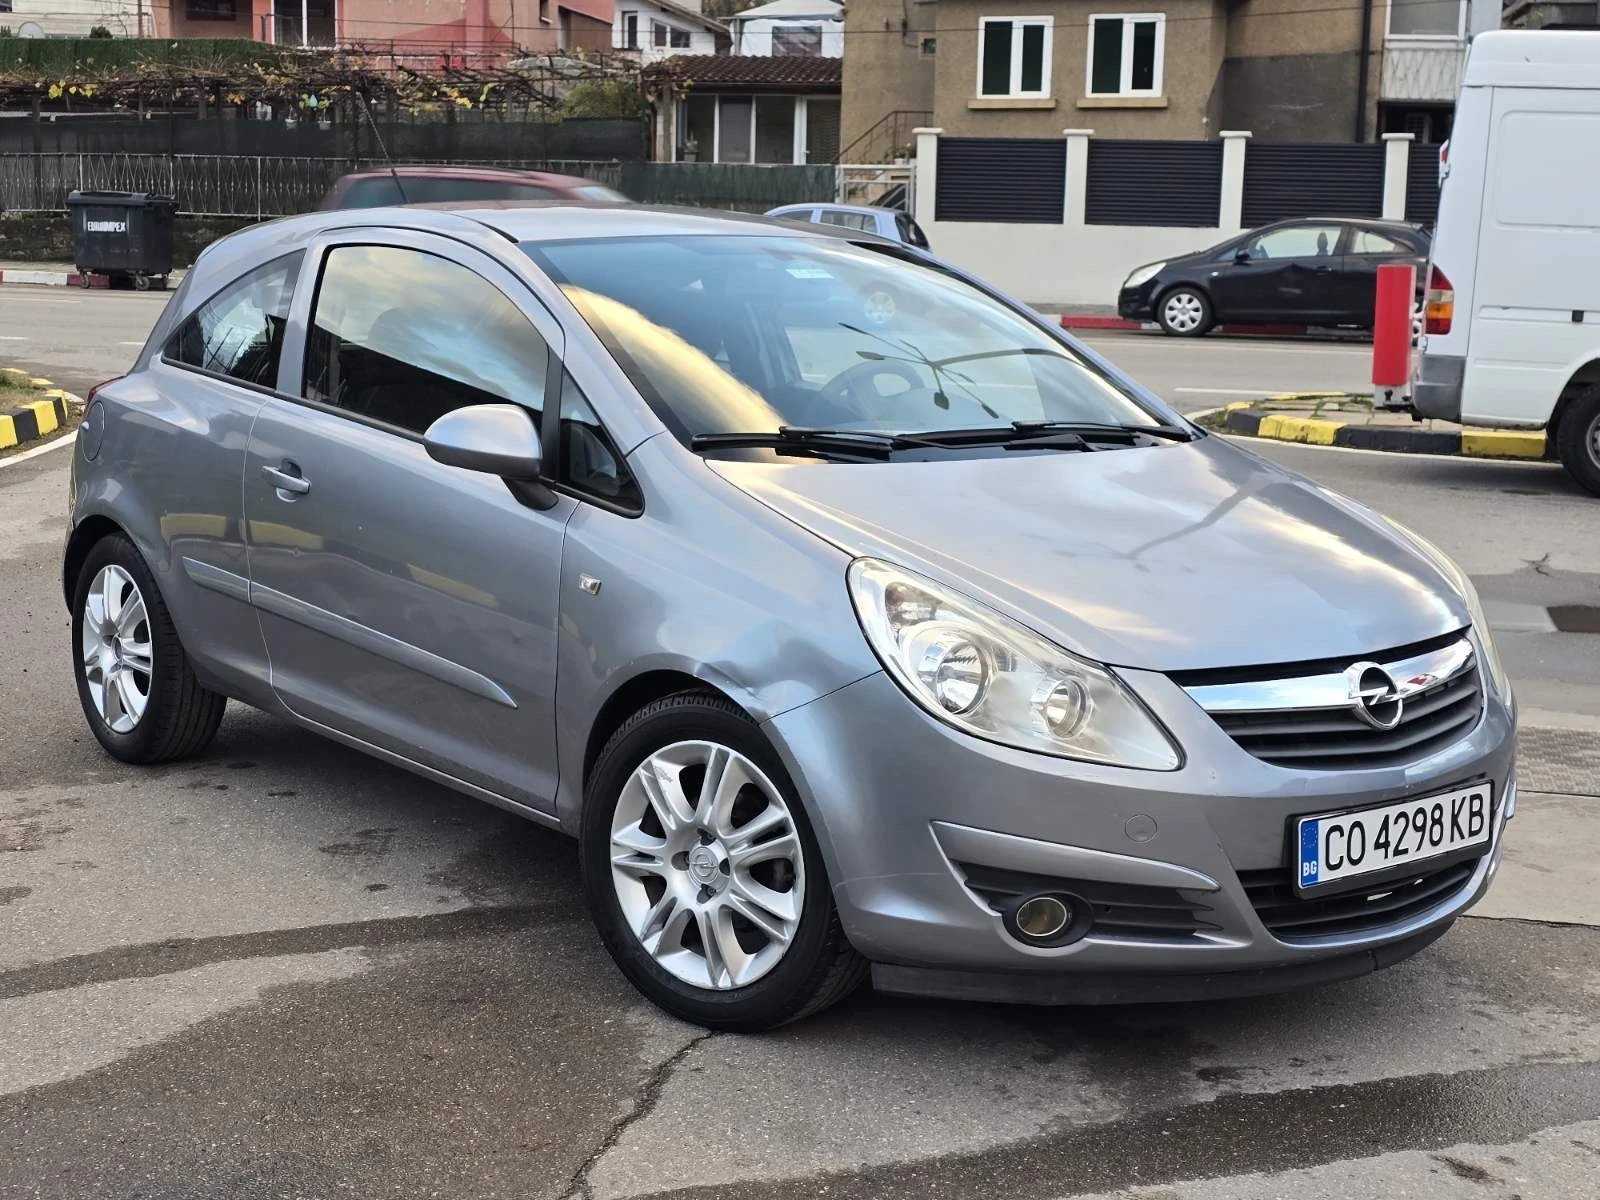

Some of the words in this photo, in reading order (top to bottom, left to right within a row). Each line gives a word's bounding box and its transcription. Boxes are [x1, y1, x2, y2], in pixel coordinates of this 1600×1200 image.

[1325, 820, 1366, 871] CO
[1374, 803, 1443, 859] 4298
[1450, 793, 1485, 843] KB
[1303, 861, 1317, 876] BG
